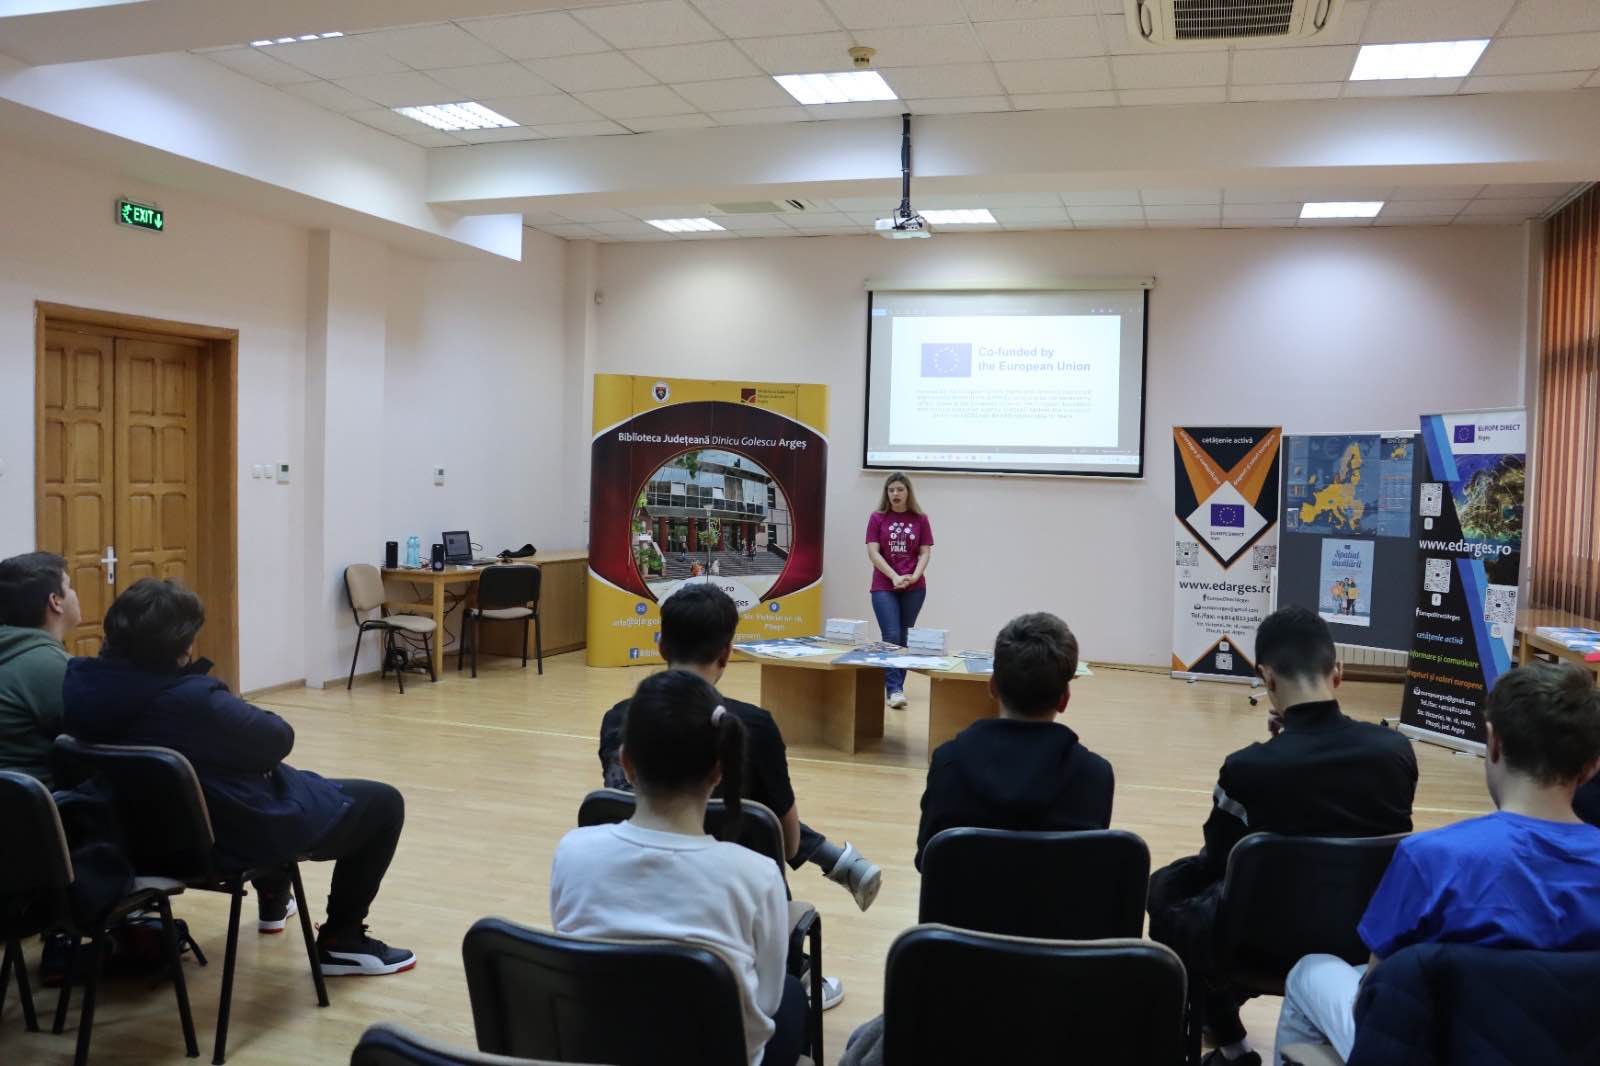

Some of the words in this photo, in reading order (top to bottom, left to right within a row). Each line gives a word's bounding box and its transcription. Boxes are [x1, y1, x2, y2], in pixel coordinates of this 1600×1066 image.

[133, 206, 154, 224] EXIT
[978, 346, 1037, 357] Co-funded
[1040, 346, 1054, 360] by
[978, 361, 995, 371] the
[999, 361, 1054, 374] European
[1057, 361, 1091, 372] Union
[618, 432, 661, 443] Biblioteca
[663, 434, 710, 447] Județeană
[712, 436, 739, 446] Dinicu
[741, 437, 777, 447] Golescu
[779, 438, 807, 449] Argeș
[1419, 538, 1511, 557] www.edarges.ro
[1179, 581, 1271, 595] www.edarges.ro
